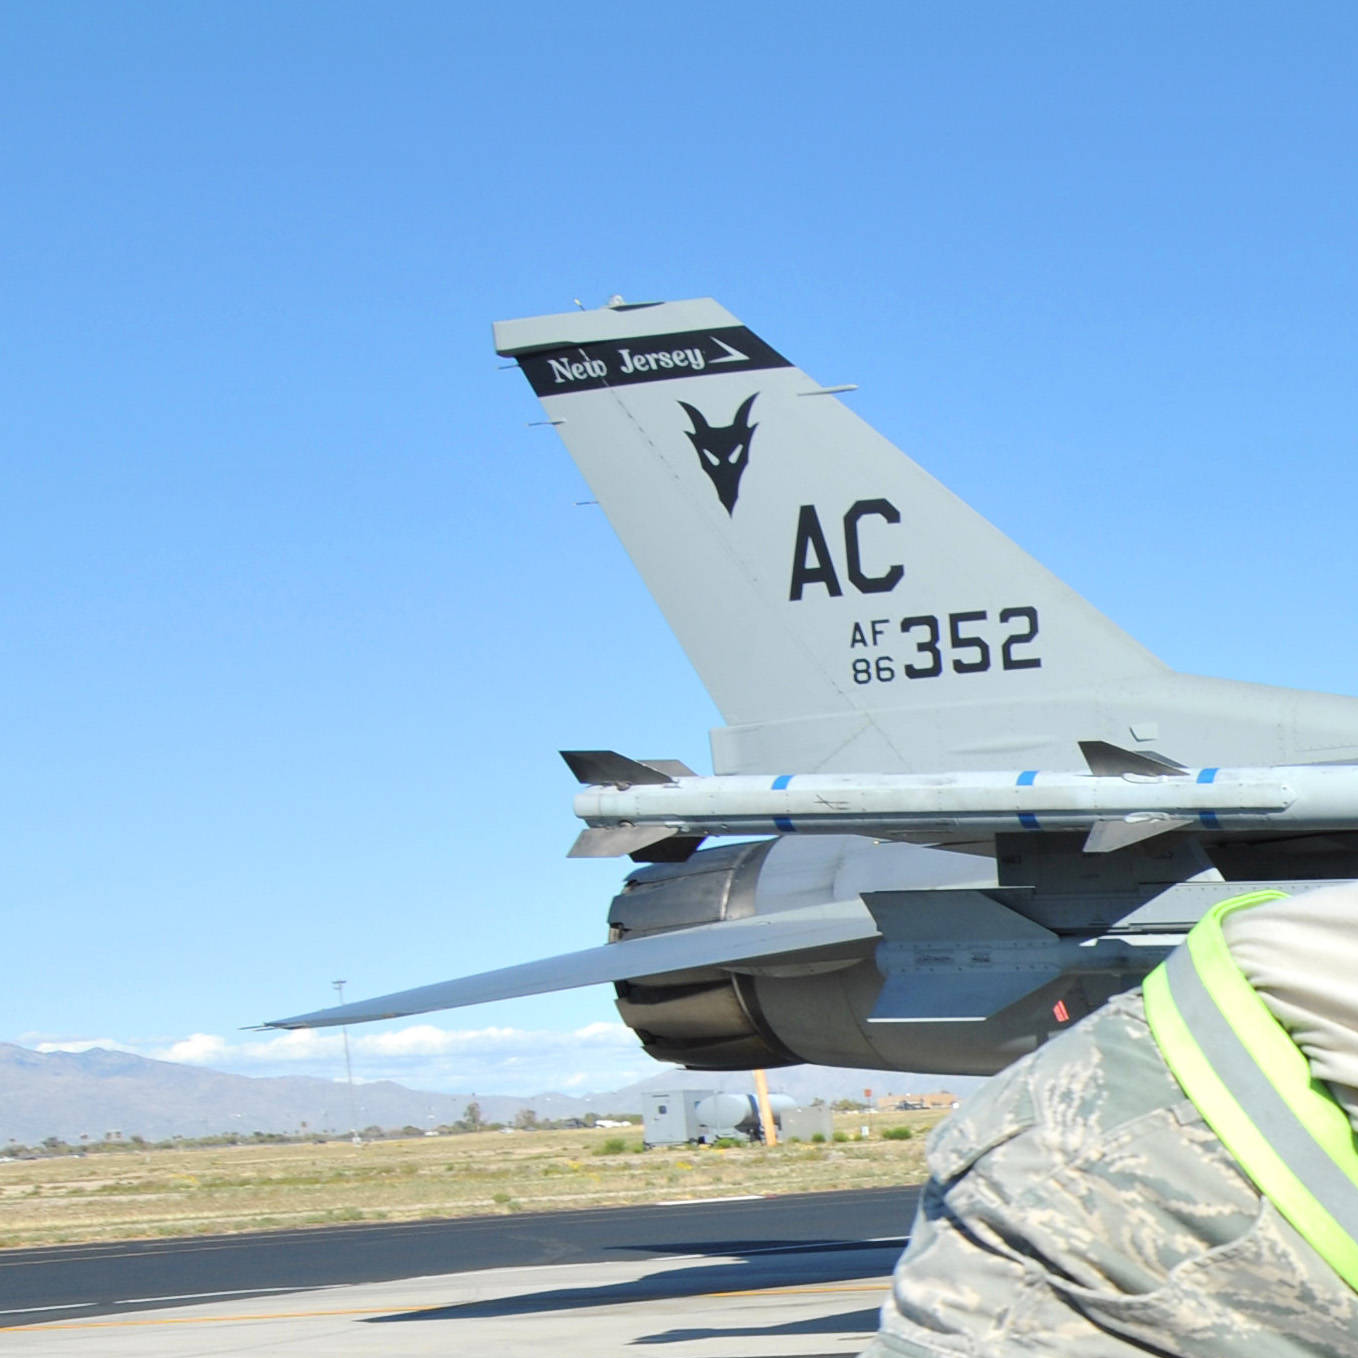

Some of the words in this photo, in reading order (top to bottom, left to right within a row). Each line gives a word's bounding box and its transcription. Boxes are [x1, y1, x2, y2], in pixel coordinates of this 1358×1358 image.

[547, 355, 608, 383] New
[617, 347, 706, 371] Jersey
[789, 498, 904, 601] AC
[850, 619, 890, 649] AF
[852, 655, 895, 685] 86
[900, 606, 1042, 680] 352
